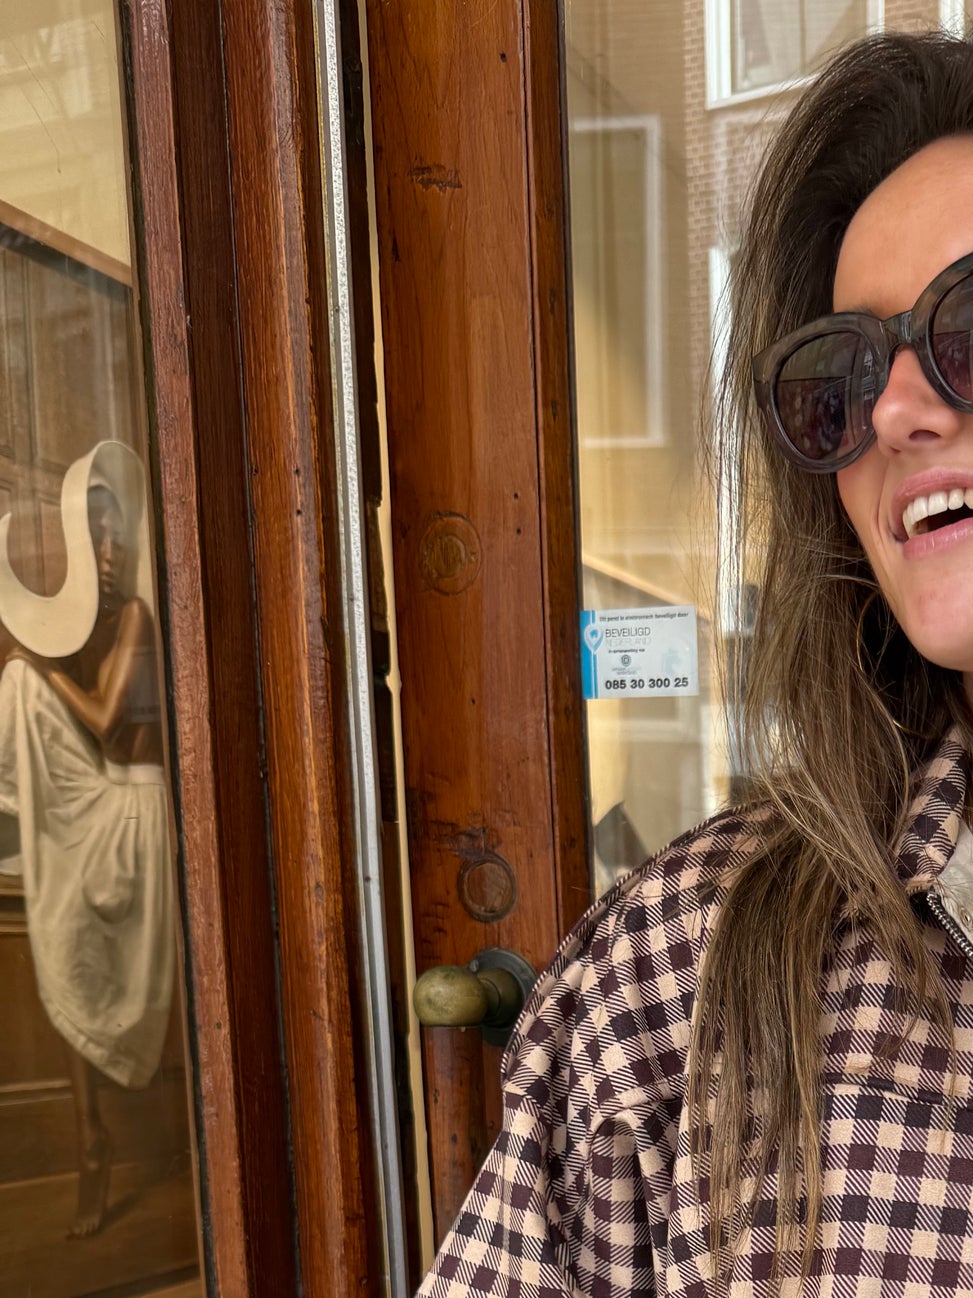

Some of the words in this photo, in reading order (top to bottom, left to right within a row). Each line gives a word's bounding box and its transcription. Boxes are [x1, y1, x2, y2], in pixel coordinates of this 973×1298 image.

[605, 626, 651, 638] BEVEILIGD
[605, 679, 627, 690] 085
[630, 679, 645, 689] 30
[648, 678, 671, 689] 300
[674, 677, 689, 688] 25
